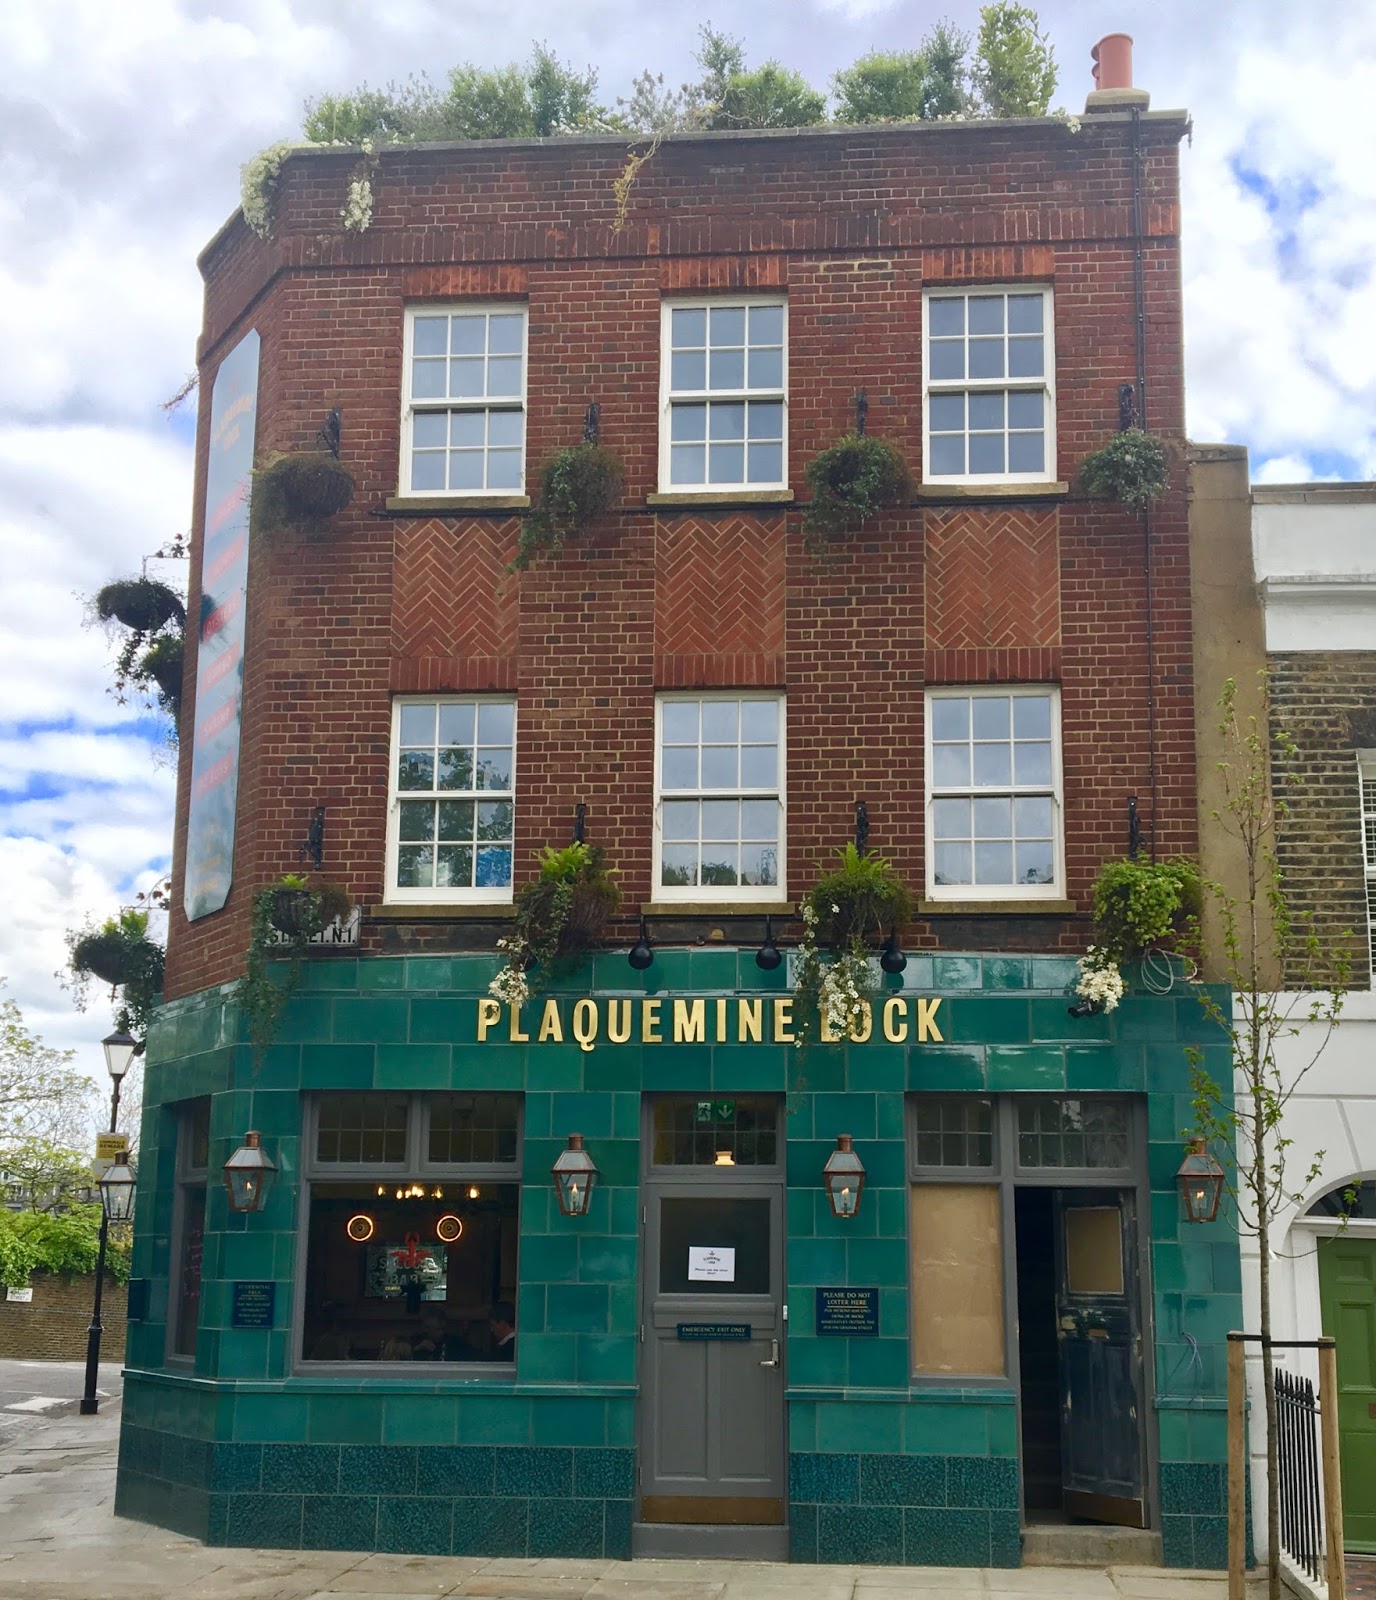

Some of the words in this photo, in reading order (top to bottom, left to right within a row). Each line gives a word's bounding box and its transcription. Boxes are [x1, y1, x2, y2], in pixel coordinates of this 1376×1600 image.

[269, 928, 329, 943] STET.
[477, 998, 795, 1051] PLAQUEMINE
[820, 998, 944, 1042] LOCK
